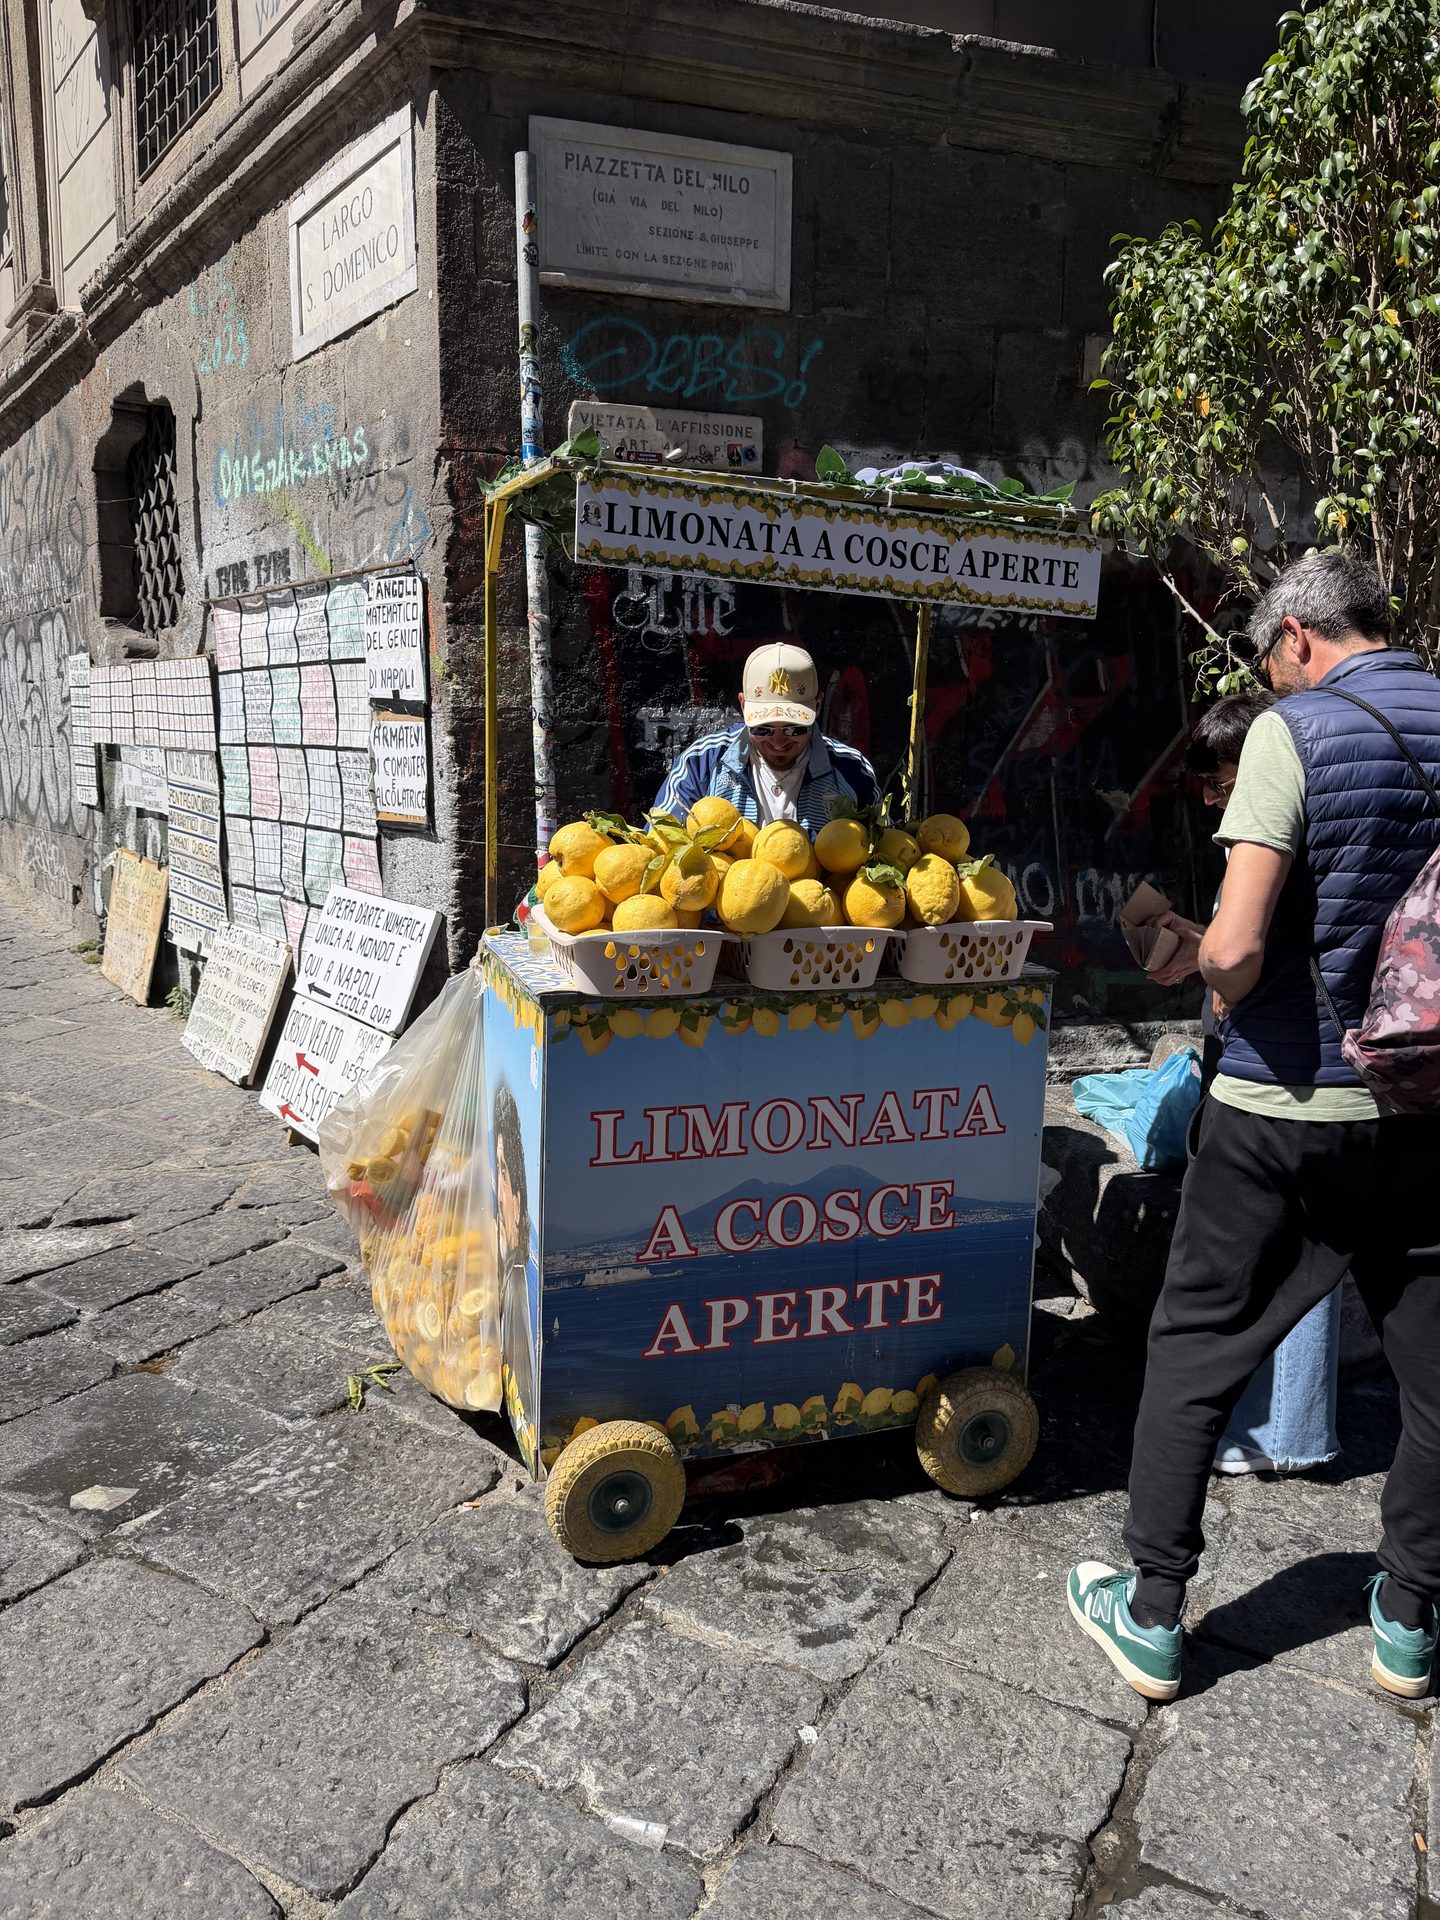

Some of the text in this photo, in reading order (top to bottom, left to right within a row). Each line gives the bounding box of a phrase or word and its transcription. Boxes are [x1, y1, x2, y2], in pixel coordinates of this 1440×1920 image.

[564, 152, 750, 195] PIAZZETTA DEL NILO
[321, 186, 374, 251] LARGO
[629, 195, 648, 209] VIA
[661, 200, 680, 213] DEL
[693, 204, 723, 222] NILO)
[649, 225, 694, 241] SEZIONE
[306, 223, 399, 313] S. DOMENICO
[576, 243, 609, 258] LIMITE
[615, 248, 639, 261] CON
[644, 252, 657, 264] LA
[662, 254, 707, 269] SEZIONE
[580, 411, 753, 439] VIETATA L'AFFISSIONE
[604, 502, 1080, 589] LIMONATA A COSCE APERTE
[365, 602, 418, 627] MATEMATICO
[366, 629, 418, 651] DEL GENIO
[369, 667, 415, 690] DI NAPOLI
[373, 724, 424, 750] ARMATEVI
[383, 755, 426, 778] COMPUTER
[375, 786, 427, 809] ALCOLATRICE
[391, 778, 397, 789] E
[326, 896, 427, 944] OPERA D'ARTE NUMERICA
[314, 922, 344, 948] UNICA
[342, 930, 357, 951] AL
[355, 934, 395, 964] MONDO
[304, 953, 382, 1000] QUI A NAPOLI
[335, 992, 392, 1025] ECCOLA QUA
[284, 1009, 384, 1064] CRISTO VELATO PRIMA
[341, 1060, 369, 1082] DEST
[355, 1049, 366, 1065] A
[589, 1084, 1006, 1167] LIMONATA
[636, 1179, 956, 1263] A COSCE
[641, 1272, 943, 1359] APERTE
